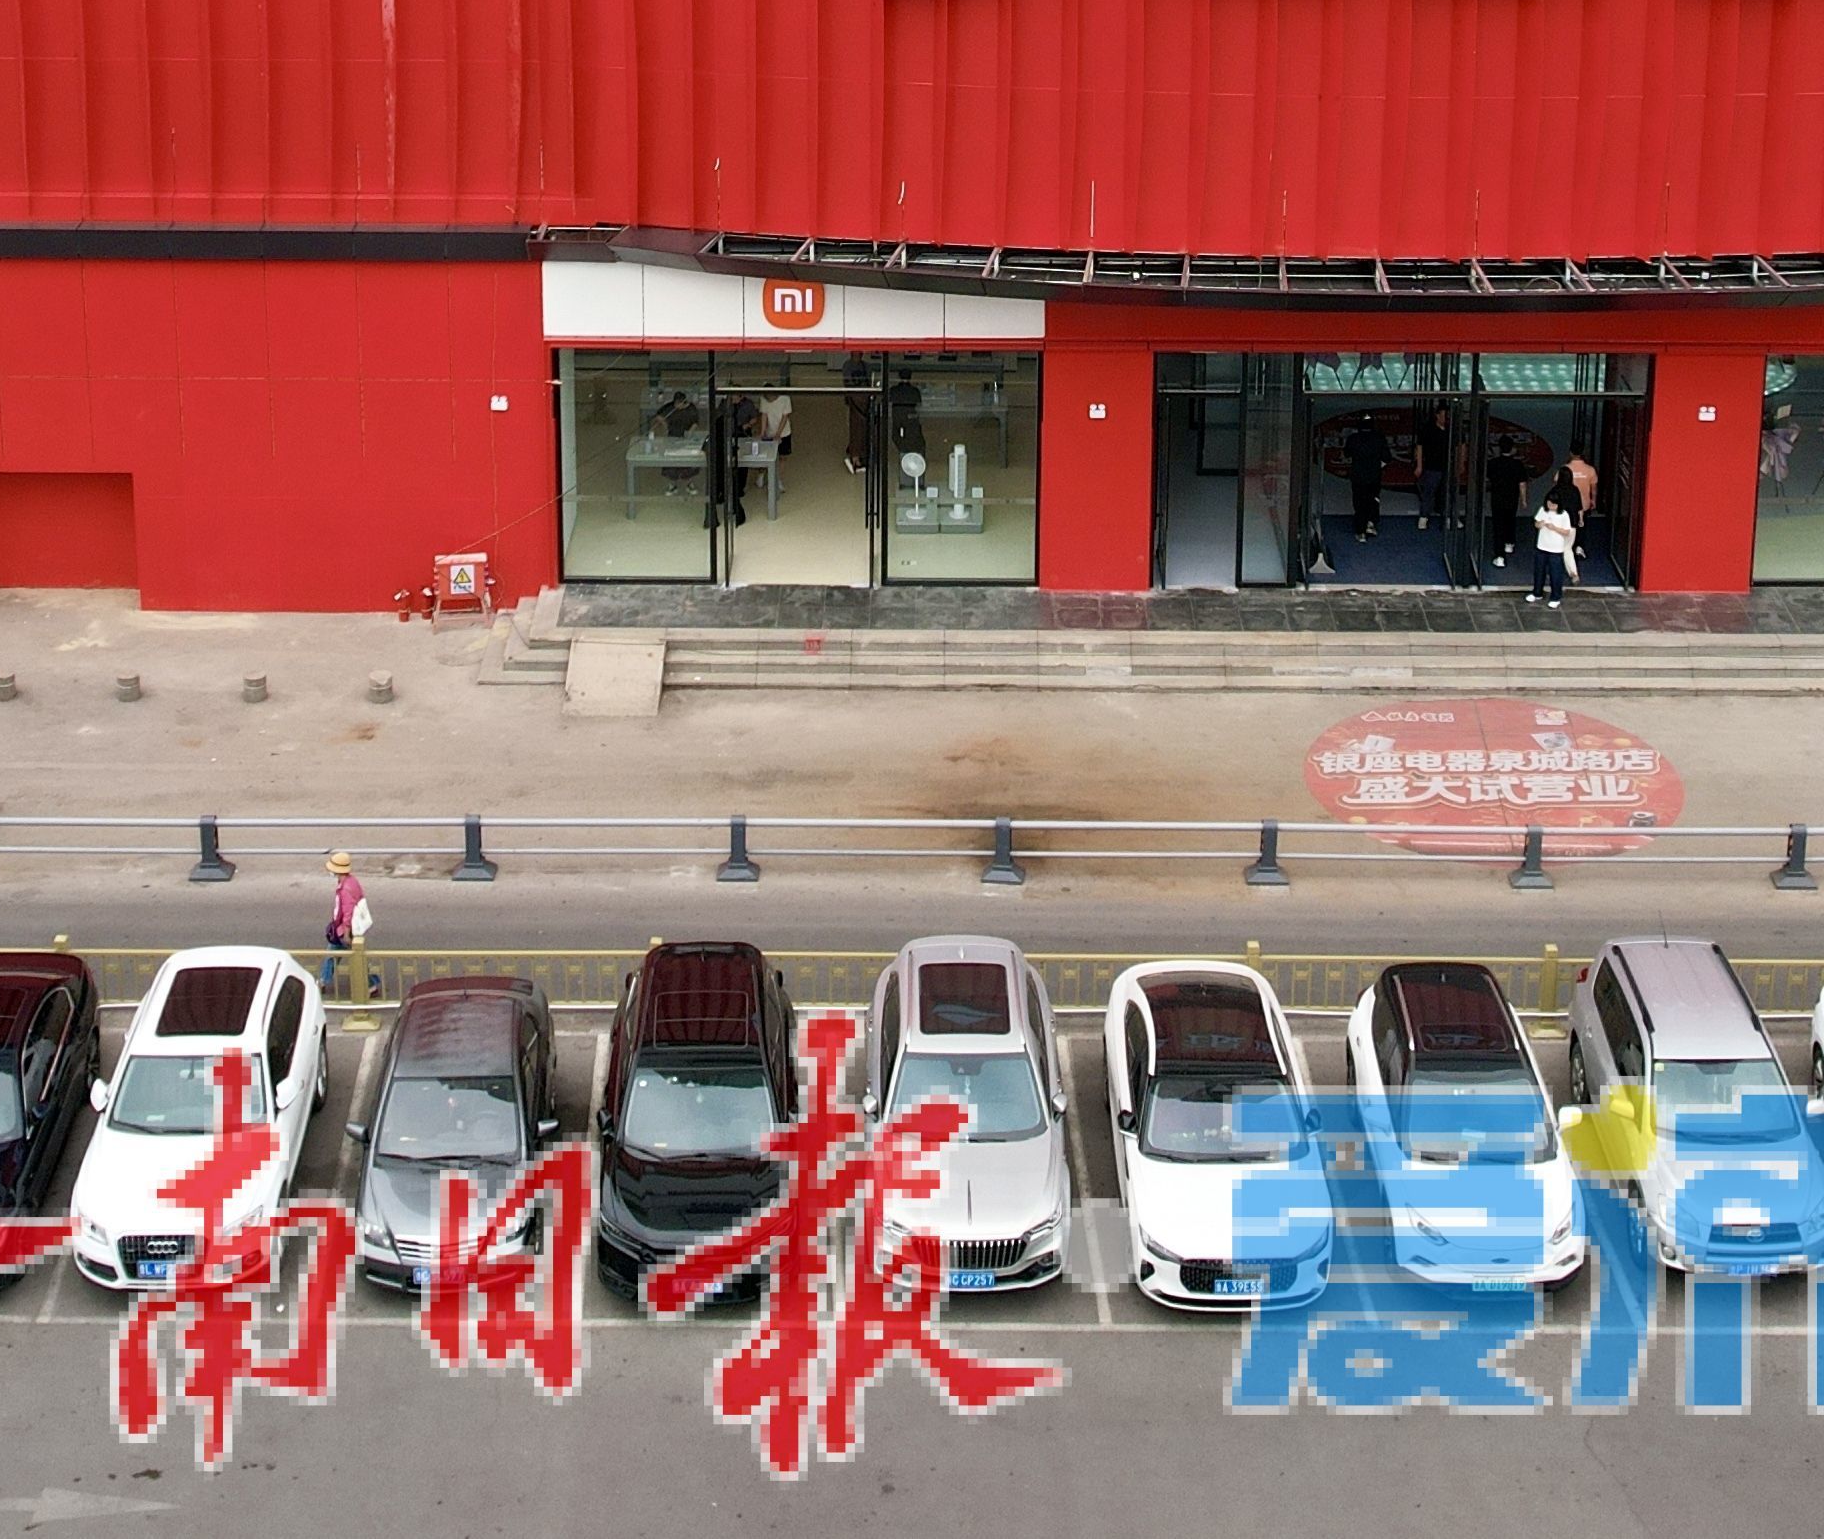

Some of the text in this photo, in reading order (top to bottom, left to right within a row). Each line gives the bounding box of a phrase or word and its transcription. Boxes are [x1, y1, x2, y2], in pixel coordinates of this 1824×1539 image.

[1319, 750, 1658, 774] 银座电器泉城路店
[1342, 775, 1640, 805] 盛大试营业
